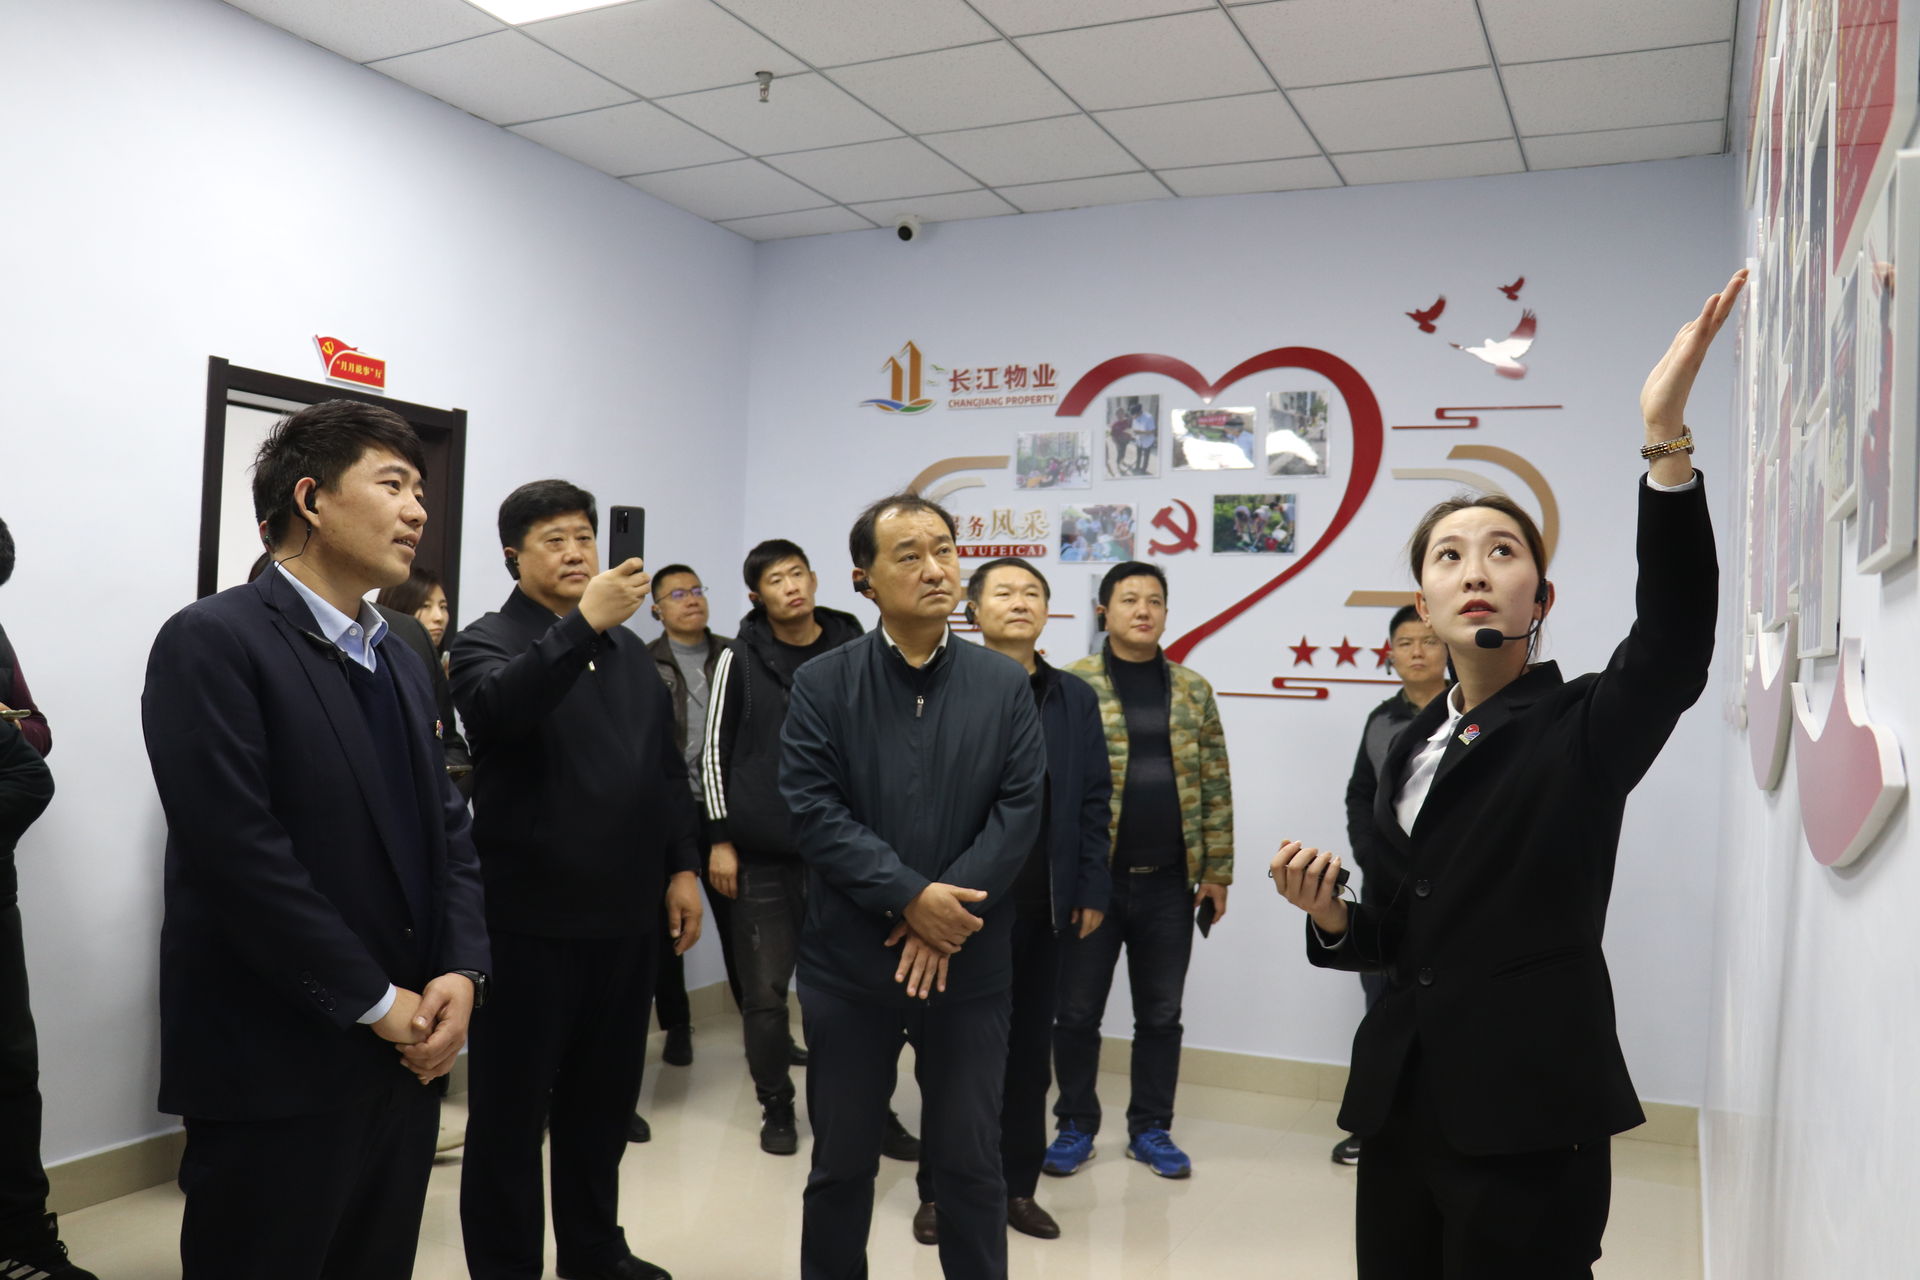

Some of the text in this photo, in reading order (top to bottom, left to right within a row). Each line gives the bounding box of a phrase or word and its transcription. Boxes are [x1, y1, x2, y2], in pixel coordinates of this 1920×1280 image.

[949, 363, 1056, 393] 长江物业
[948, 394, 1055, 409] CHANGJIANG PROPERTY
